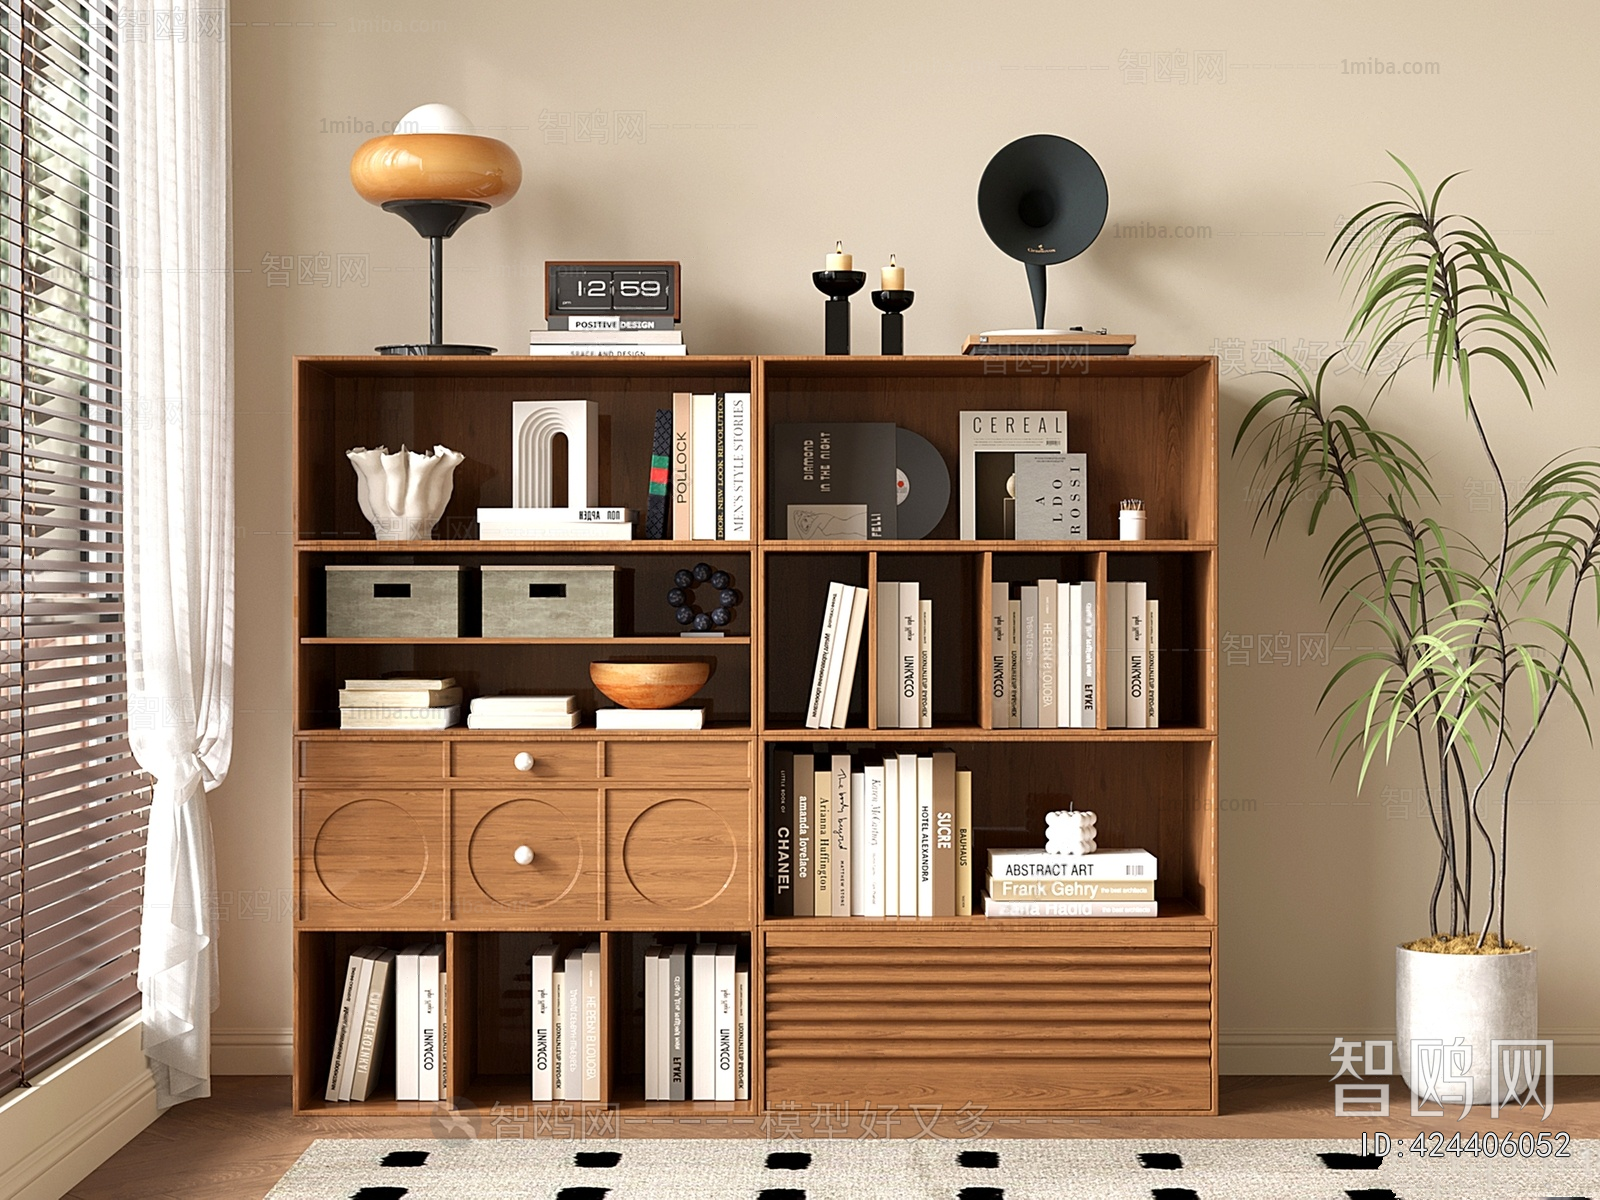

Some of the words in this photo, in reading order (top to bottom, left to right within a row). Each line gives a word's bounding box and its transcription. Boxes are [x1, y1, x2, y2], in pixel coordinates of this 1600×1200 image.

[577, 280, 606, 297] 12
[620, 280, 660, 297] 59
[575, 320, 618, 329] POSITIVE
[620, 320, 655, 329] DESIGN
[717, 396, 725, 458] REVOLUTION
[733, 399, 744, 452] STORIES
[973, 416, 1063, 434] CEREAL
[803, 439, 814, 481] DIAMOND
[820, 432, 831, 460] NIGHT
[676, 430, 688, 505] POLLOCK
[717, 460, 725, 486] LOOK
[733, 453, 744, 492] STYLE
[820, 464, 831, 480] THE
[717, 489, 725, 510] NEW
[820, 483, 831, 492] IN
[1070, 466, 1081, 535] ROSSI
[717, 511, 725, 538] DIOR.
[733, 494, 744, 533] MEN'S
[837, 768, 848, 789] The
[870, 778, 881, 802] Karen
[799, 795, 809, 835] amanda
[819, 797, 830, 836] Arianna
[837, 792, 848, 814] body
[921, 805, 929, 832] HOTEL
[936, 811, 952, 849] SUCRE
[777, 826, 790, 894] CHANEL
[799, 837, 810, 878] lovelace
[921, 833, 929, 883] ALEXANDRA
[959, 828, 968, 866] BAUHAUS
[817, 838, 830, 891] Huffington
[1005, 863, 1068, 877] ABSTRACT
[1070, 863, 1095, 877] ART
[1002, 881, 1047, 897] Frank
[1051, 881, 1099, 900] Gehry
[1045, 902, 1093, 917] Hadid
